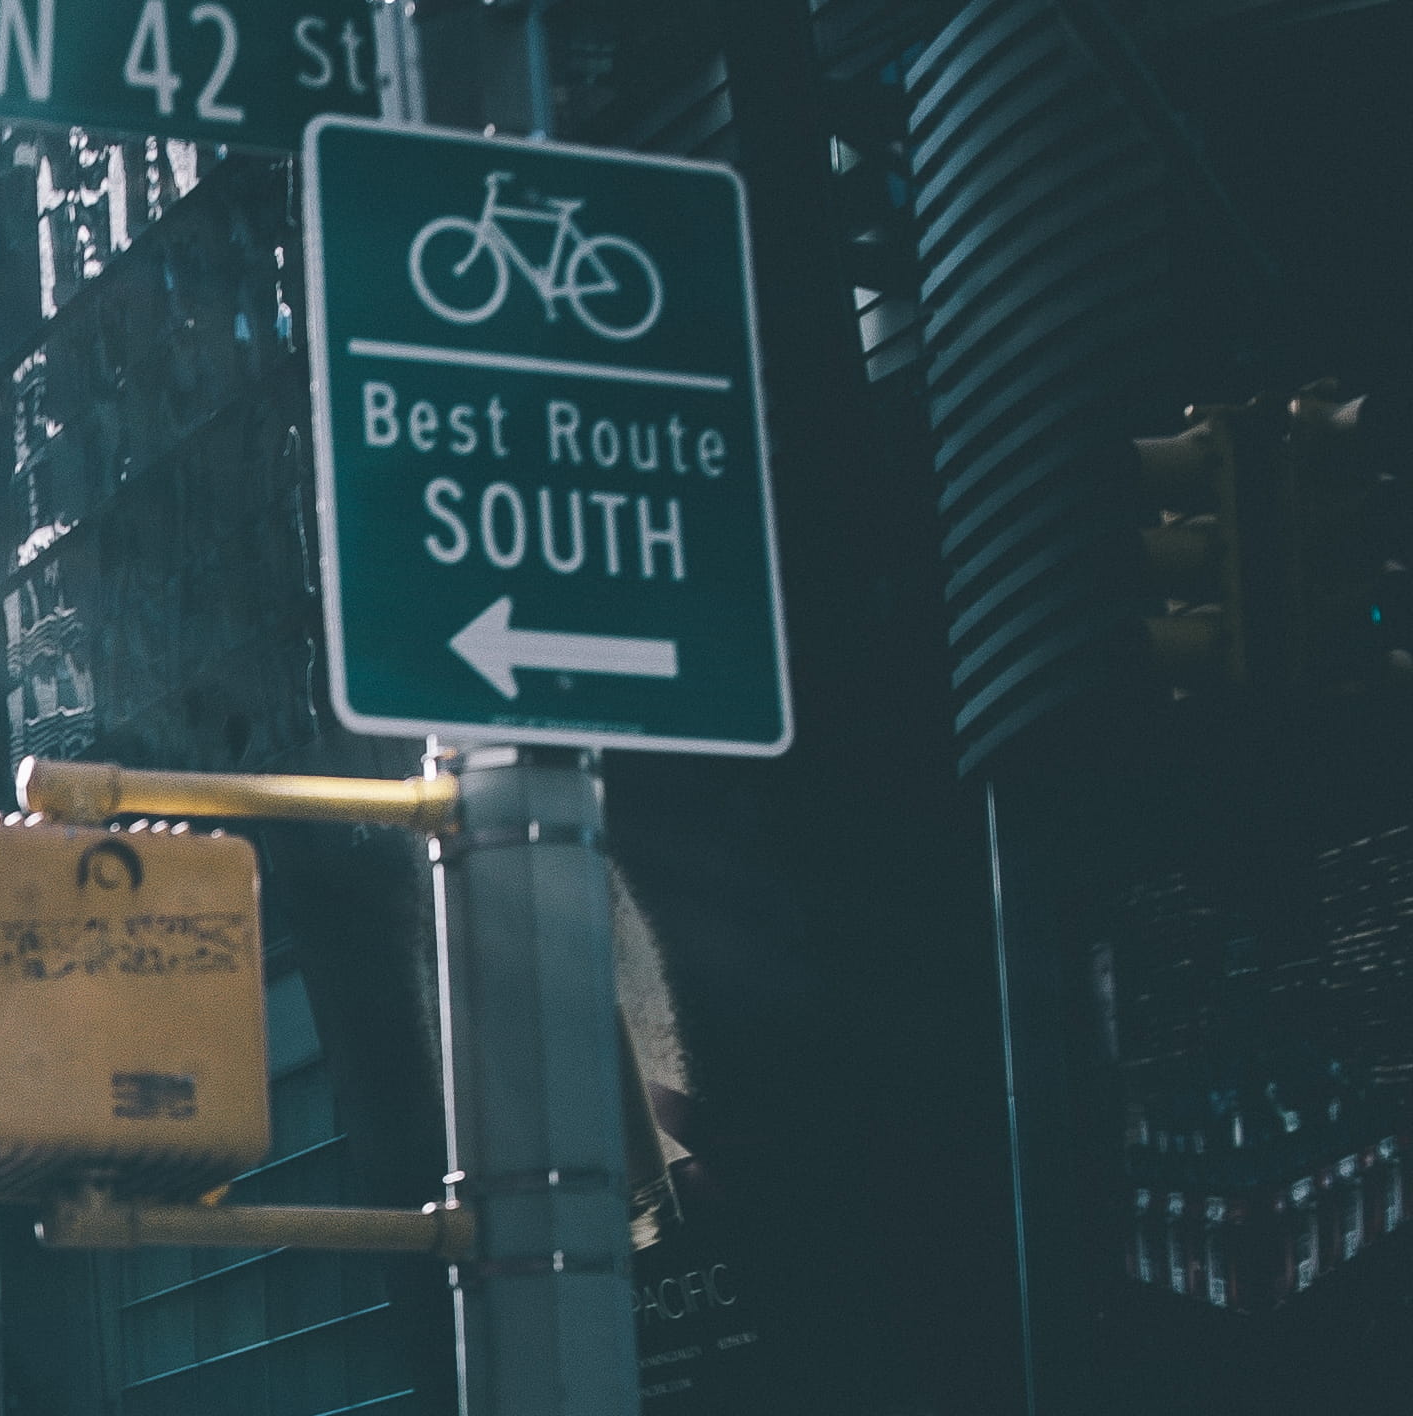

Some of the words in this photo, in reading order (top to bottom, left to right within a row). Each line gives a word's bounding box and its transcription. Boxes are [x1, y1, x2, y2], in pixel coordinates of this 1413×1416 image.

[124, 0, 245, 123] 42
[295, 15, 367, 93] St
[361, 379, 510, 459] Best
[547, 398, 727, 478] Route
[423, 476, 686, 582] SOUTH
